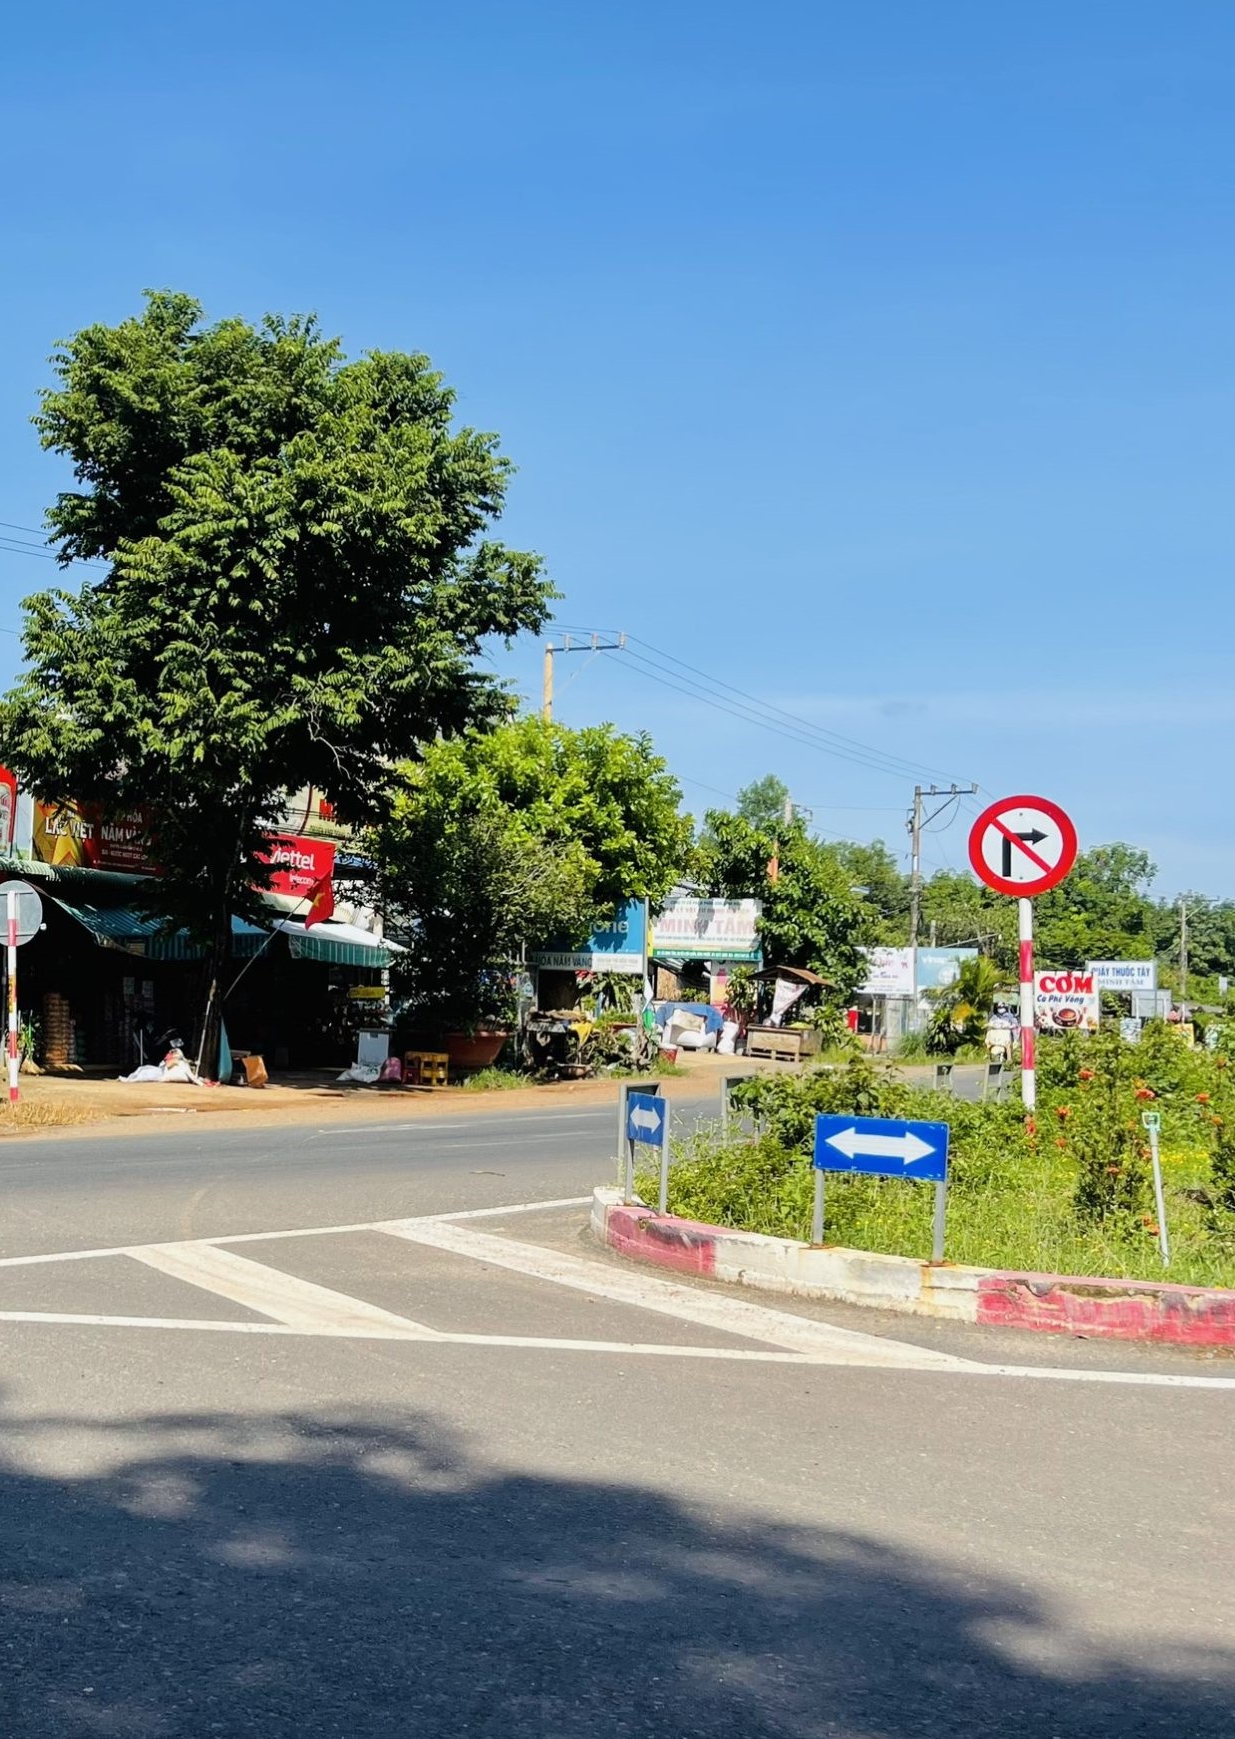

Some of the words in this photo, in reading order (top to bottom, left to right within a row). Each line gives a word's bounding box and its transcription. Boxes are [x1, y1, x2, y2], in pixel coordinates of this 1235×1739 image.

[1112, 965, 1134, 977] THUỐC
[1137, 965, 1150, 977] TÂY
[1039, 971, 1093, 994] CƠM
